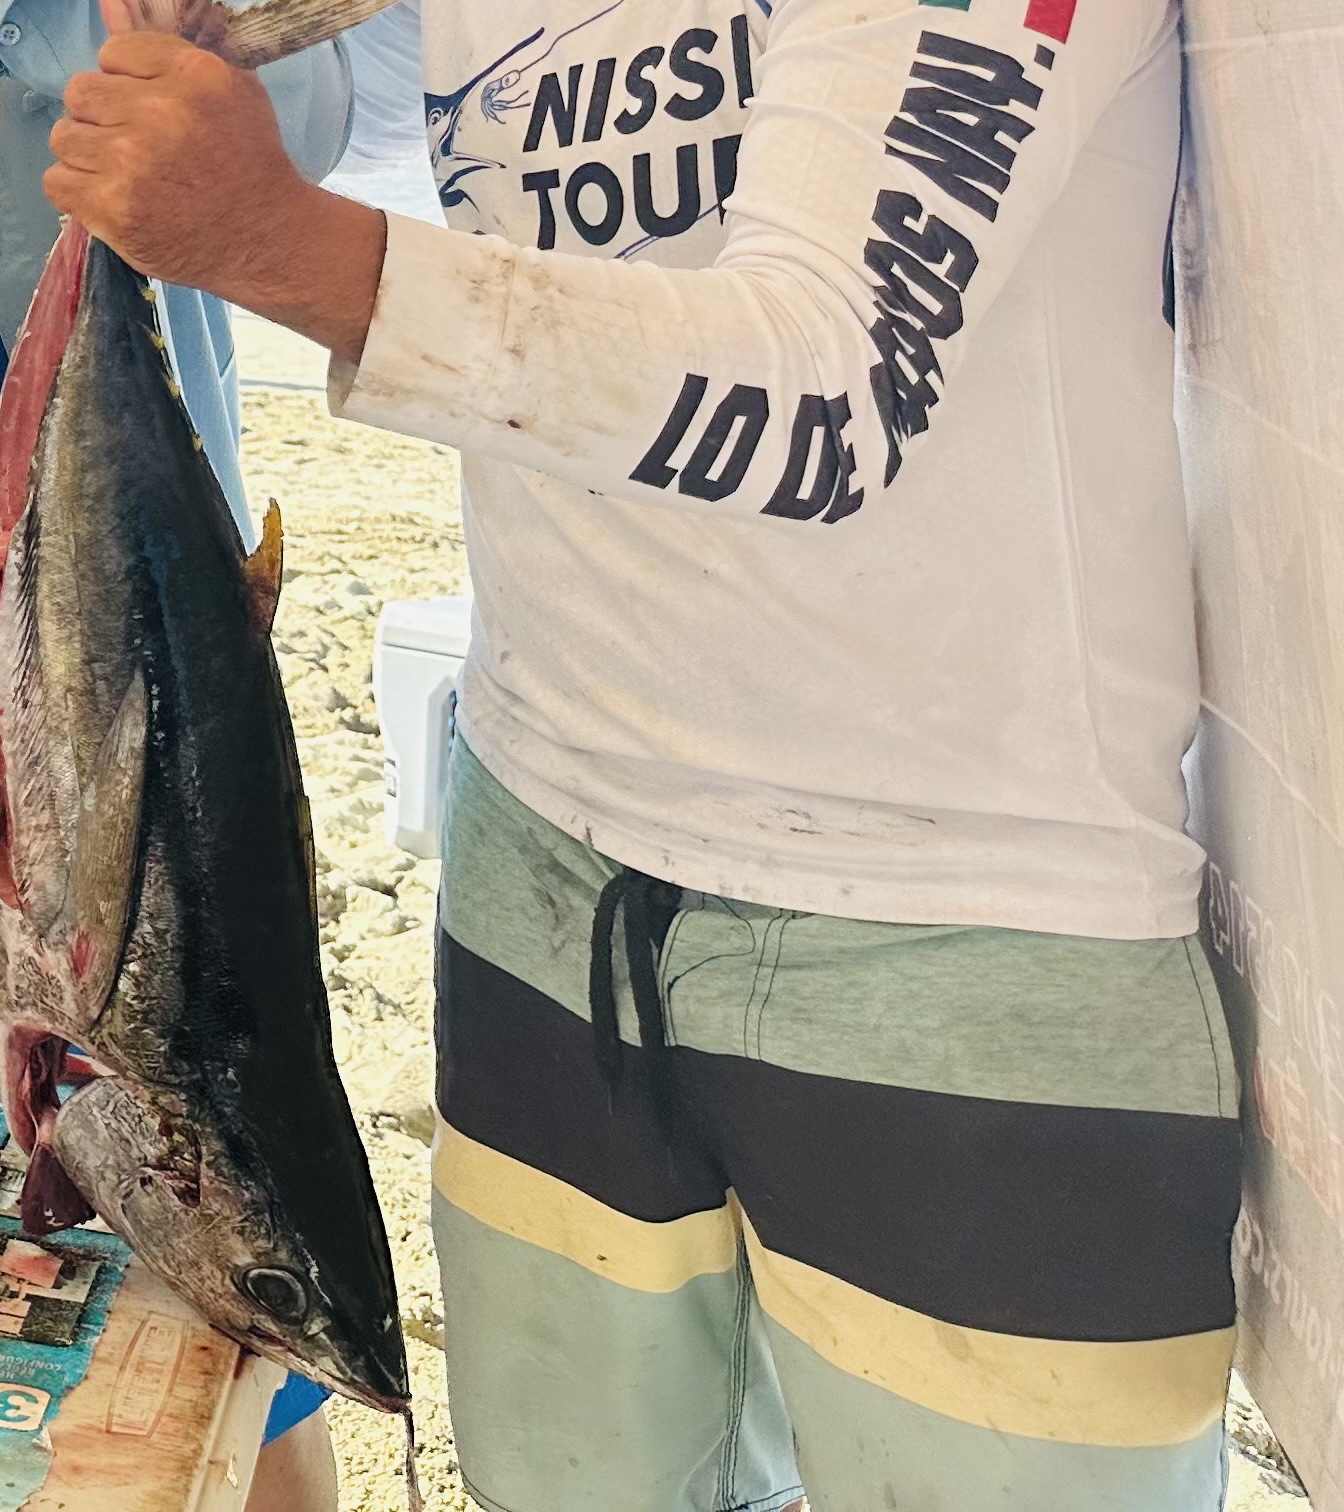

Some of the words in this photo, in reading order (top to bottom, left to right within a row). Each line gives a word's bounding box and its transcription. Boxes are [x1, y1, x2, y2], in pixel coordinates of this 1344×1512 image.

[522, 13, 755, 153] NISSI
[521, 133, 743, 251] TOU
[628, 372, 770, 503] LO
